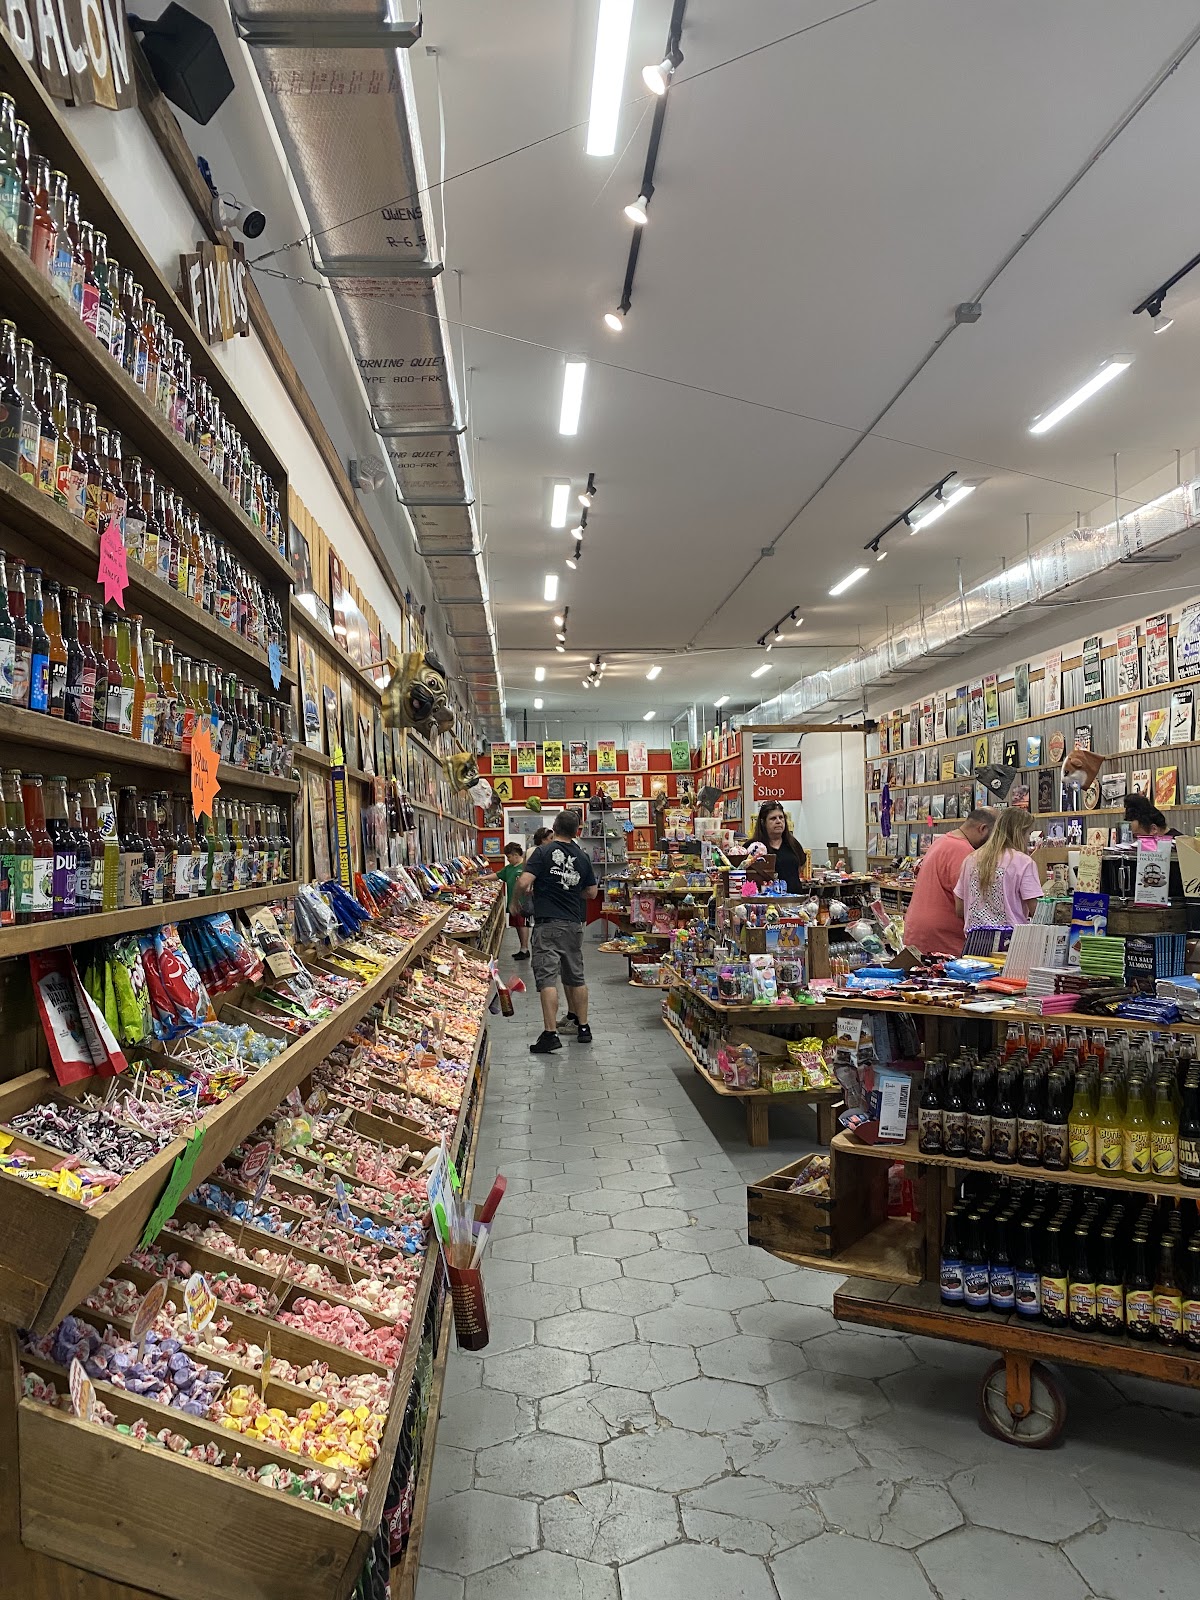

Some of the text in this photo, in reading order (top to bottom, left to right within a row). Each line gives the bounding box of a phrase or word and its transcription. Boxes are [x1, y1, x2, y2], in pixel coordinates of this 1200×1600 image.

[381, 207, 423, 221] OWENS
[393, 374, 443, 384] 800-FRK
[411, 450, 442, 458] QUIET
[769, 753, 801, 766] FIZZ
[757, 766, 778, 777] Pop
[758, 787, 785, 797] Shop
[337, 815, 347, 848] GUMMY
[341, 849, 349, 887] LARGEST
[1129, 961, 1153, 969] ALMOND
[1139, 956, 1153, 964] SALT
[1154, 1143, 1173, 1153] SODA
